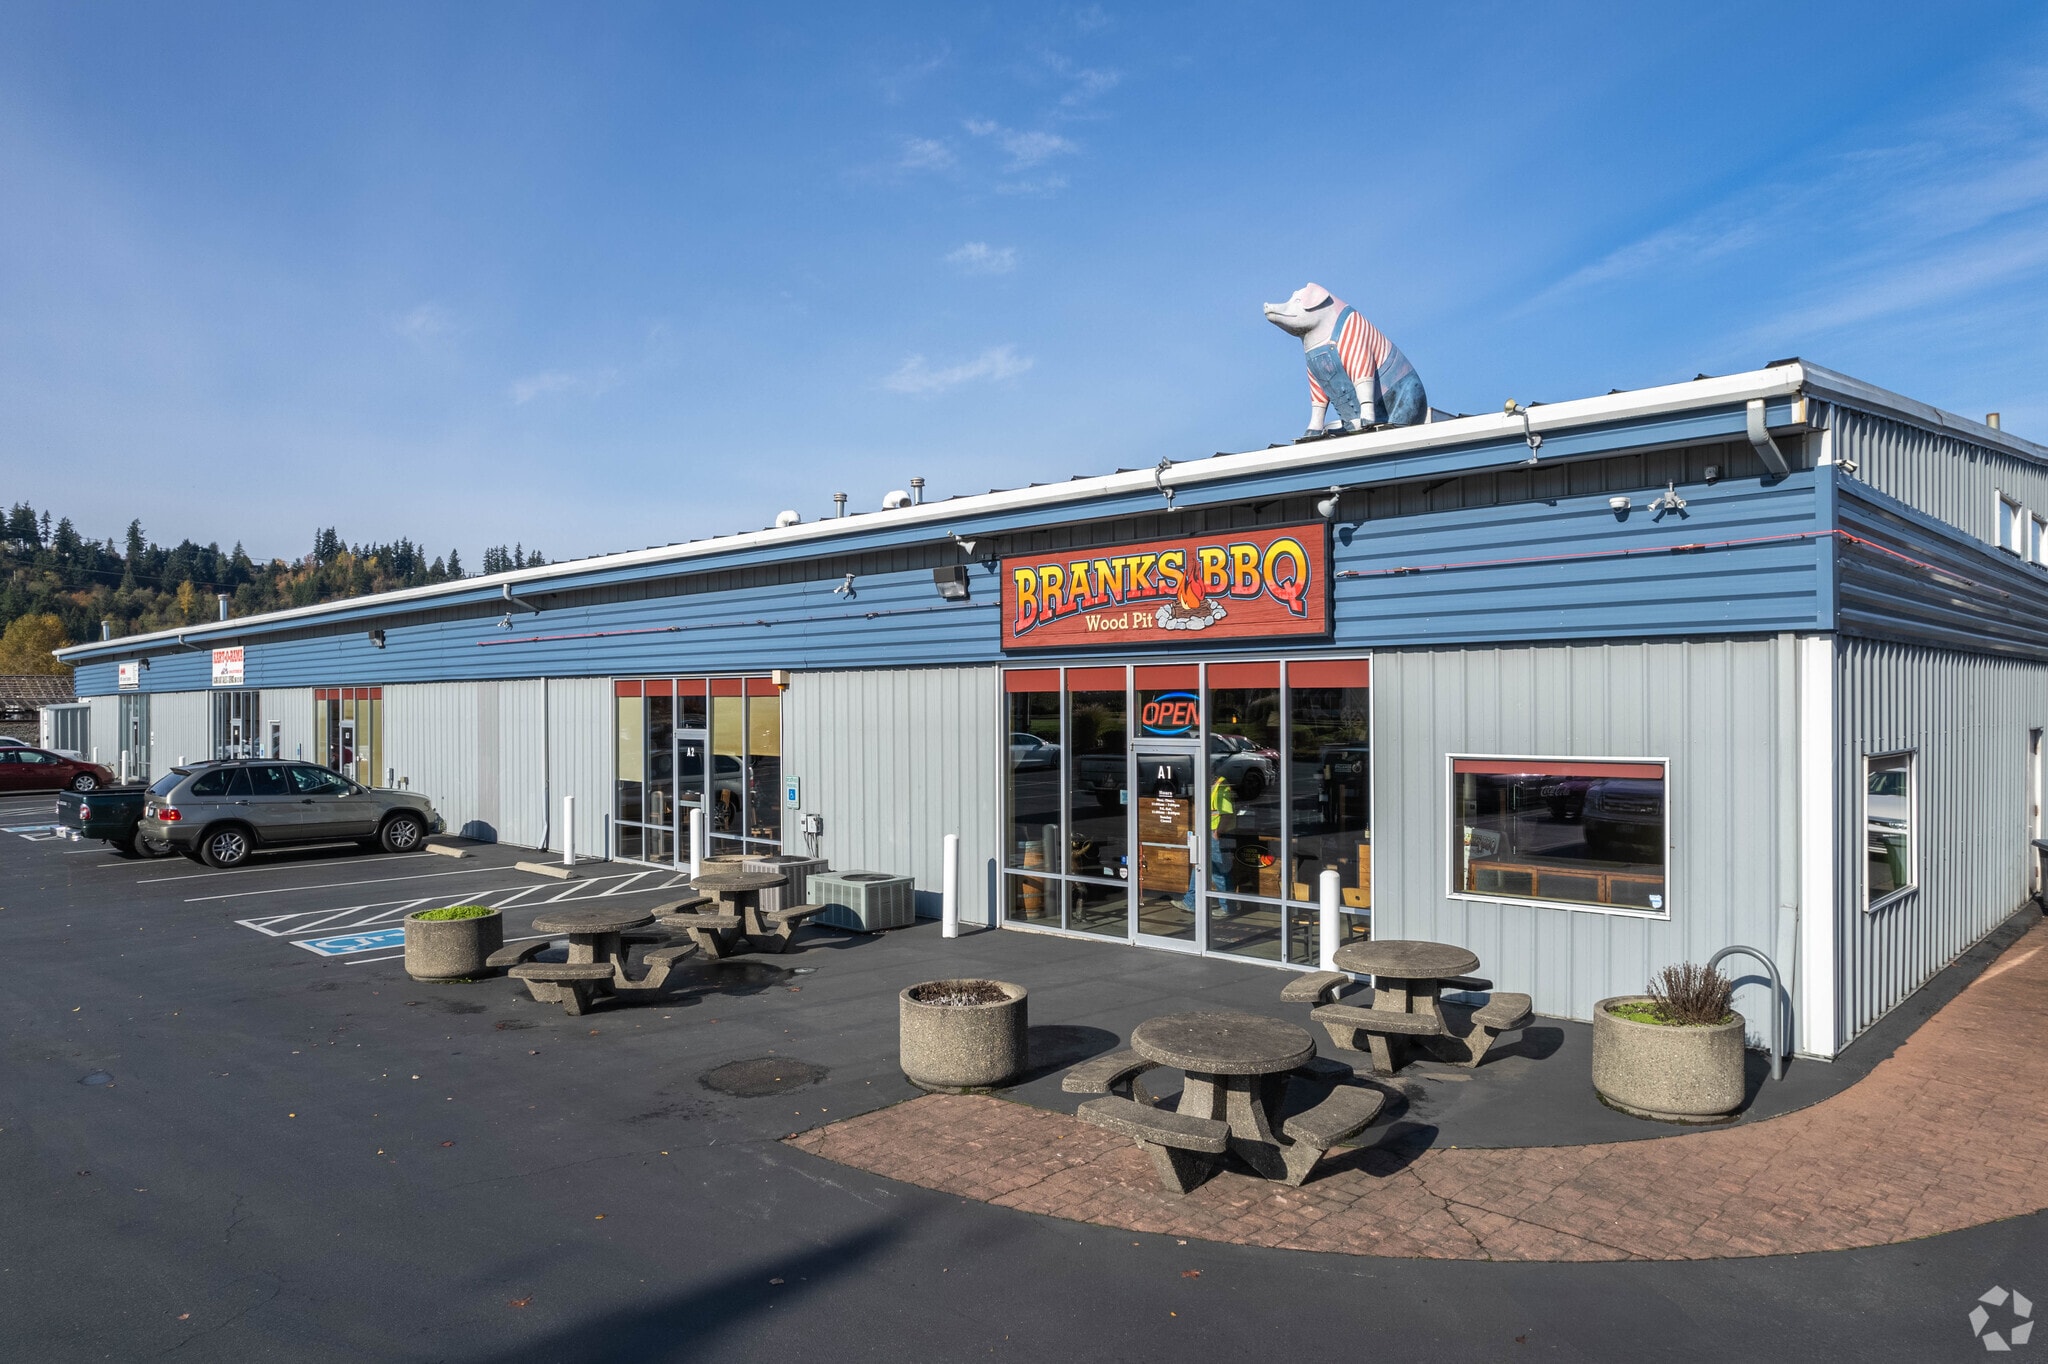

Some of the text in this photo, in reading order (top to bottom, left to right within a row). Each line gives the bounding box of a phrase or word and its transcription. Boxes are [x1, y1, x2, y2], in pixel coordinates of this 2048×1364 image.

[1013, 535, 1312, 638] BRANKS BBQ
[1085, 611, 1153, 632] Wood Pit
[1142, 702, 1200, 726] OPEN
[686, 747, 695, 757] A2
[1157, 765, 1172, 780] A1
